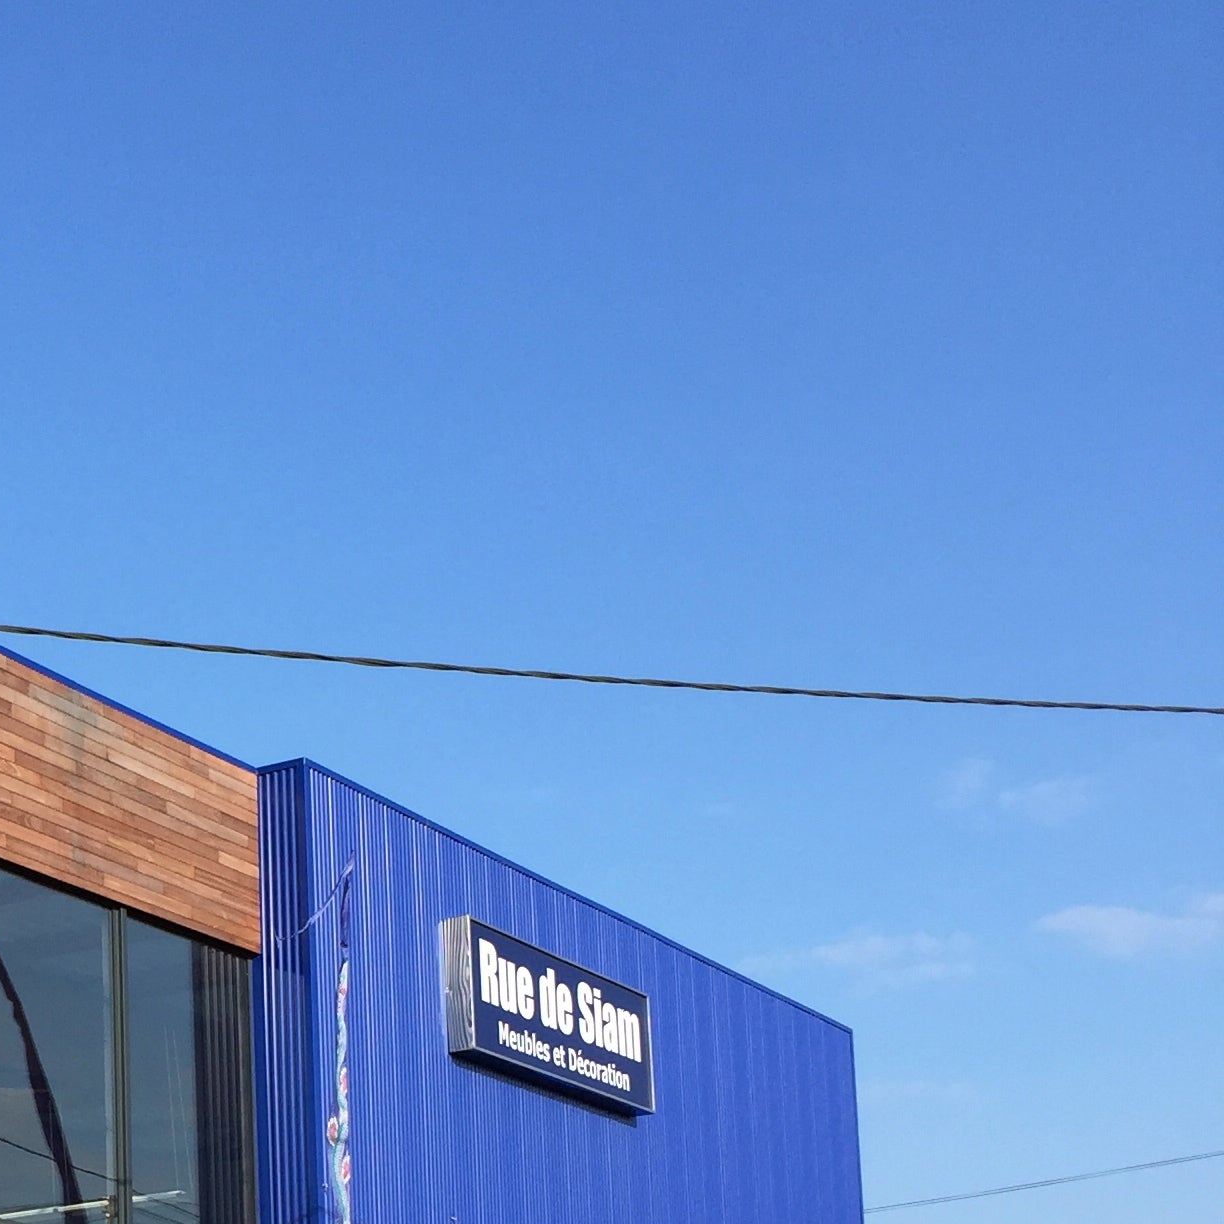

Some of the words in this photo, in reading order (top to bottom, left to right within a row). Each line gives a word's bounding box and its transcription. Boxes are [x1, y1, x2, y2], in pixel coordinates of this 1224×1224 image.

[478, 937, 535, 1020] Rue
[538, 967, 574, 1036] de
[577, 981, 642, 1063] Siam
[498, 1020, 551, 1063] Meubles
[552, 1045, 566, 1069] et
[568, 1047, 630, 1092] Décoration
